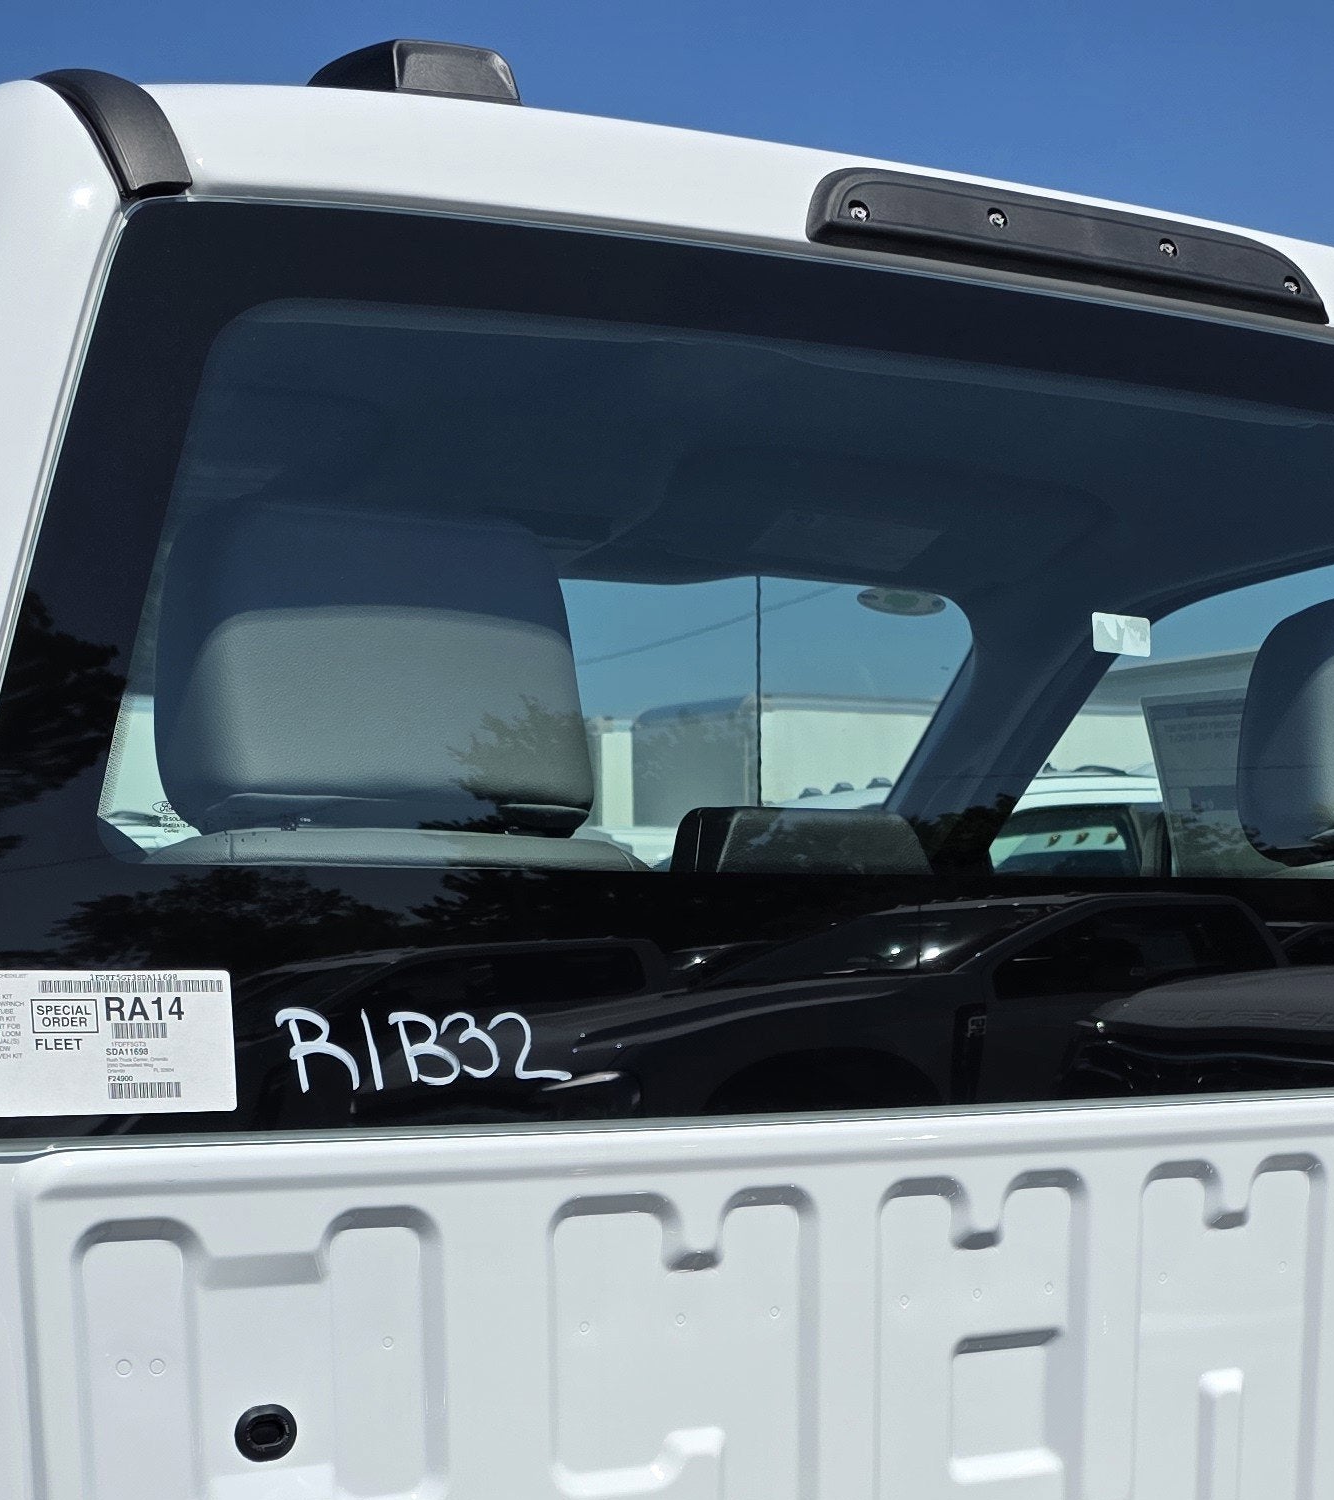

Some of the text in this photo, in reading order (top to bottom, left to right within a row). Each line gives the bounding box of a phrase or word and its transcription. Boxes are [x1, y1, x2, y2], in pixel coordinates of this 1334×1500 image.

[36, 1005, 92, 1015] SPECIAL
[105, 996, 185, 1021] RA14
[41, 1016, 88, 1028] ORDER
[35, 1038, 83, 1051] FLEET
